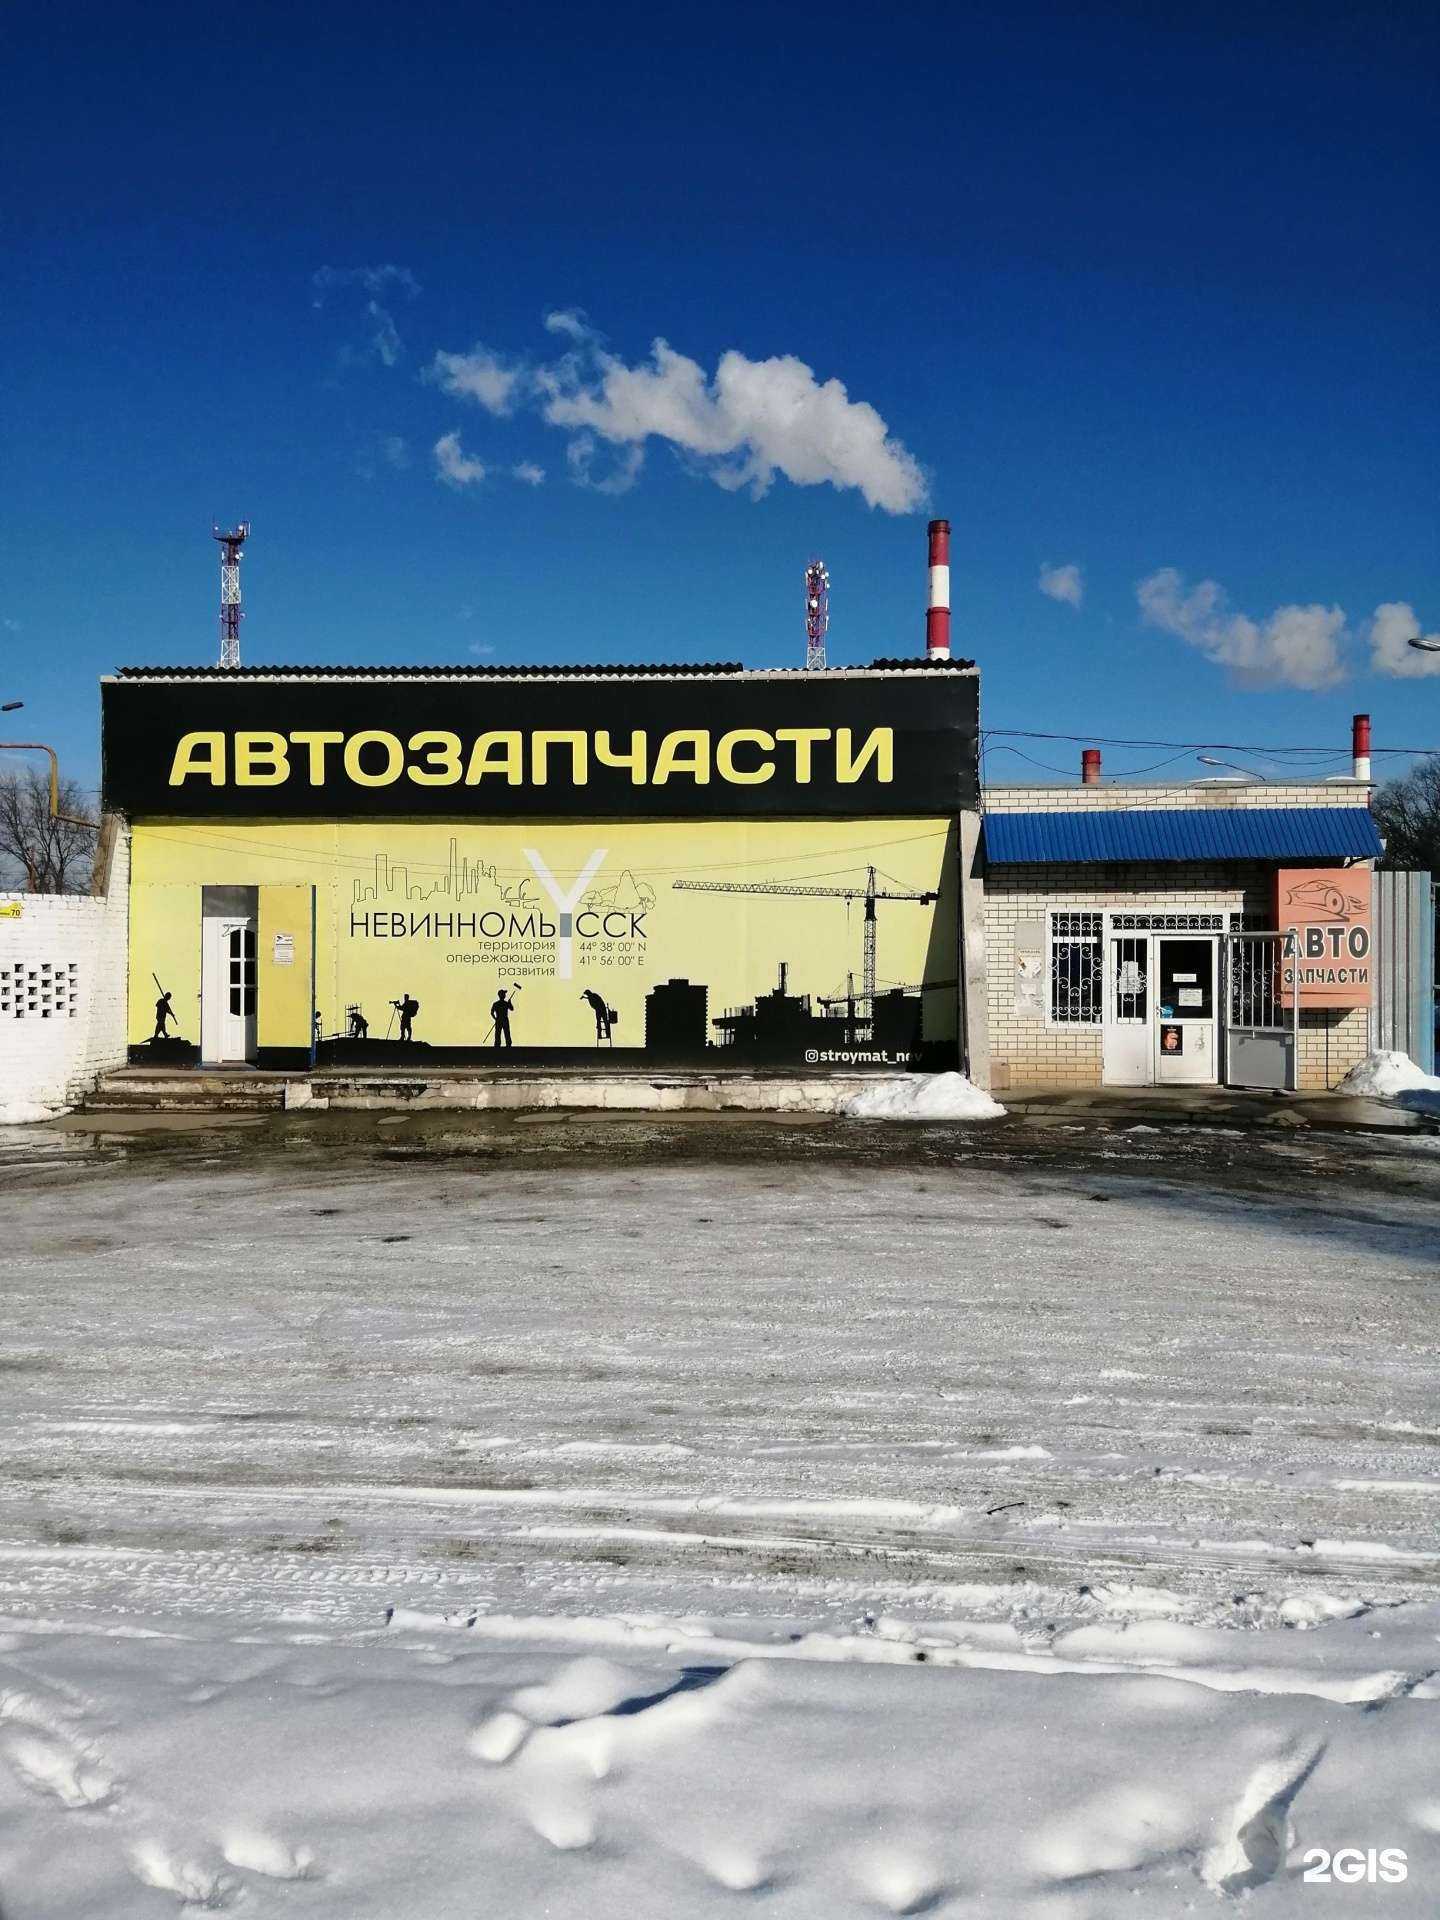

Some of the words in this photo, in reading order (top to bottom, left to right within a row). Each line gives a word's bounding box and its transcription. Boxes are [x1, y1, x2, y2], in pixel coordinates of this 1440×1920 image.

[168, 727, 894, 787] АВТОЗАПЧАСТИ
[478, 941, 556, 952] территория
[638, 942, 646, 952] N
[1282, 926, 1370, 960] АВТО
[446, 954, 556, 965] опережающего
[638, 955, 645, 966] E
[498, 967, 556, 978] развития
[1284, 968, 1369, 984] ЗАПЧАСТИ
